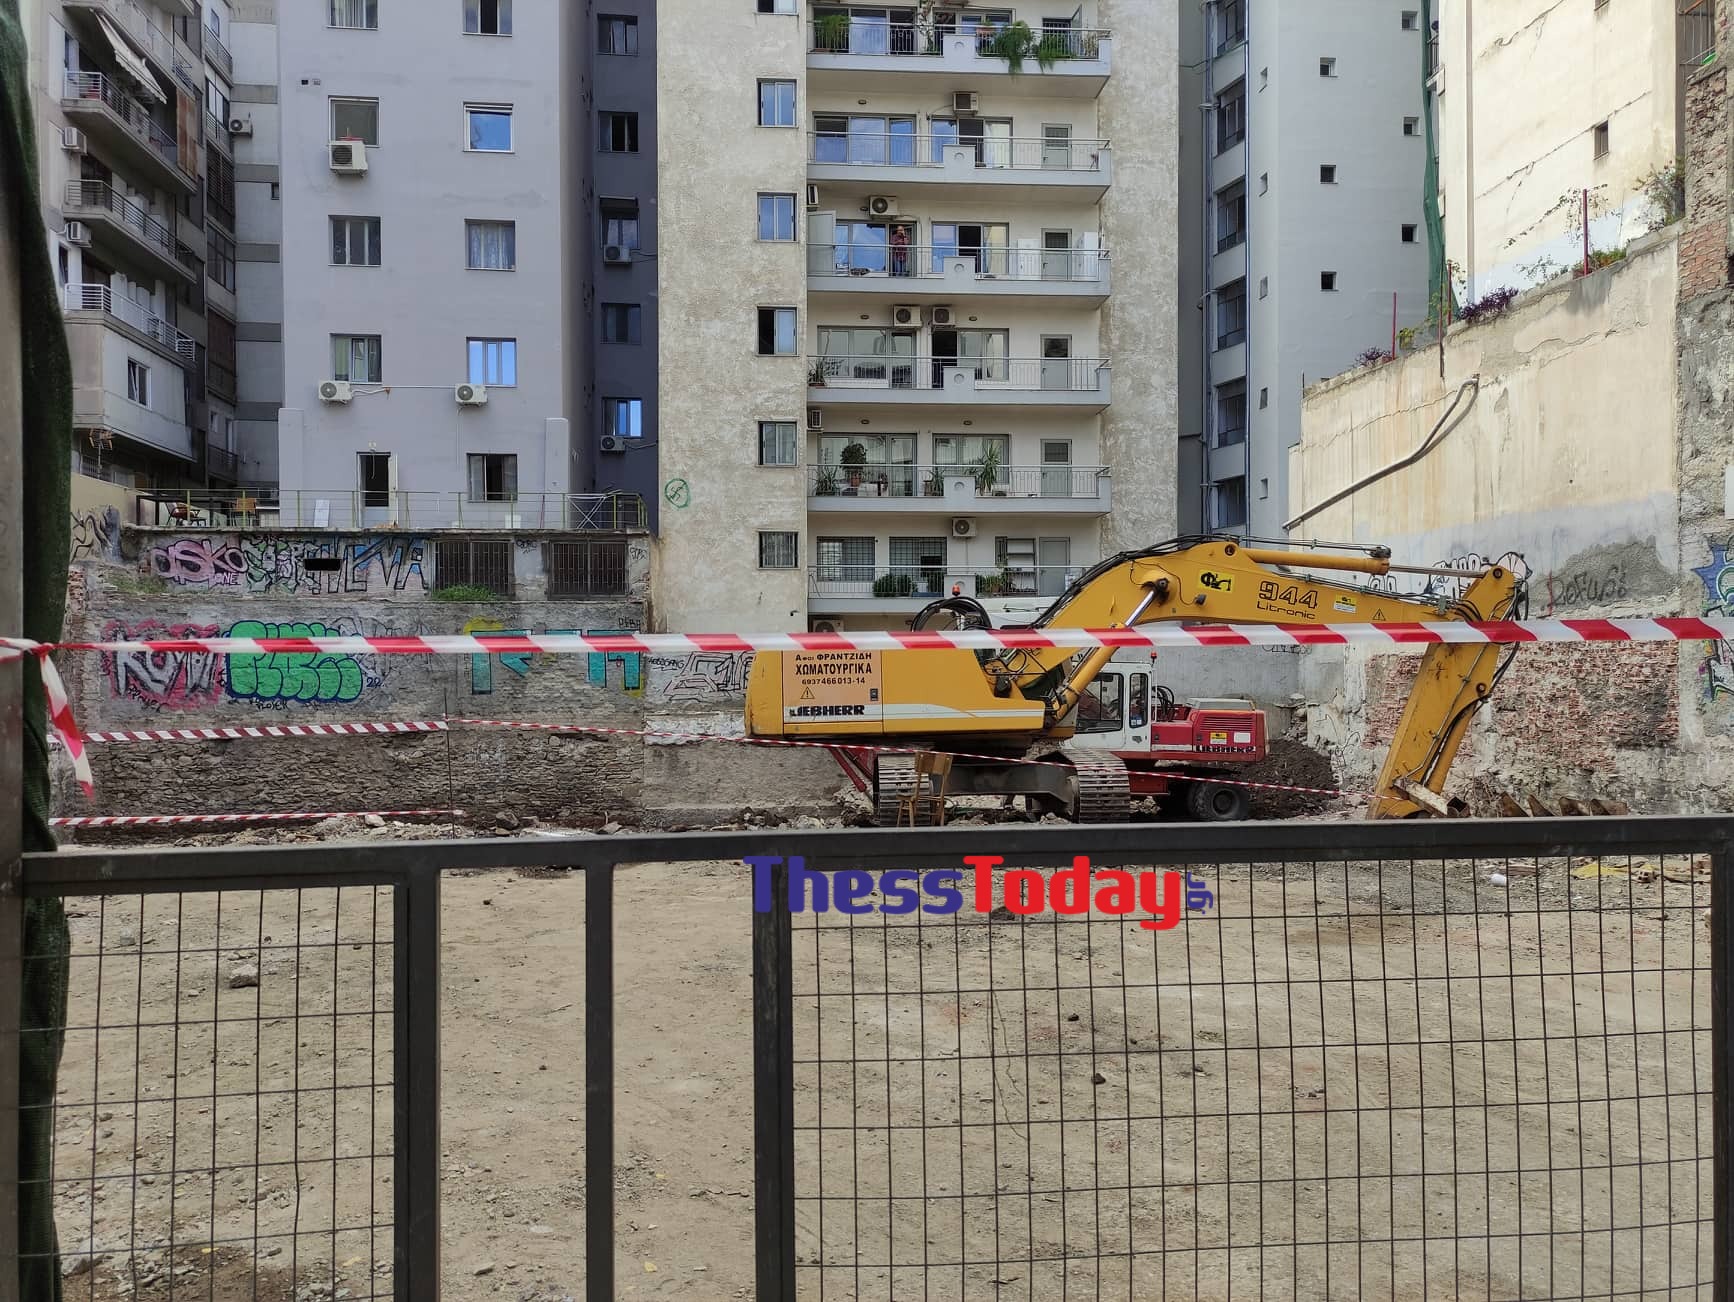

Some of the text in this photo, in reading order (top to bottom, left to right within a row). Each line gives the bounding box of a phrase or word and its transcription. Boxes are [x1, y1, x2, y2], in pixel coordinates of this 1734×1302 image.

[1258, 580, 1318, 609] 944
[1256, 600, 1316, 620] Litronic
[816, 652, 872, 661] ΦΡΑΝΤΖΙΔΗ
[795, 662, 873, 676] ΧΩΜΑΤΟΥΡΓΙΚΑ
[801, 676, 865, 685] 6937466013-14
[789, 704, 865, 717] LIEBHERR
